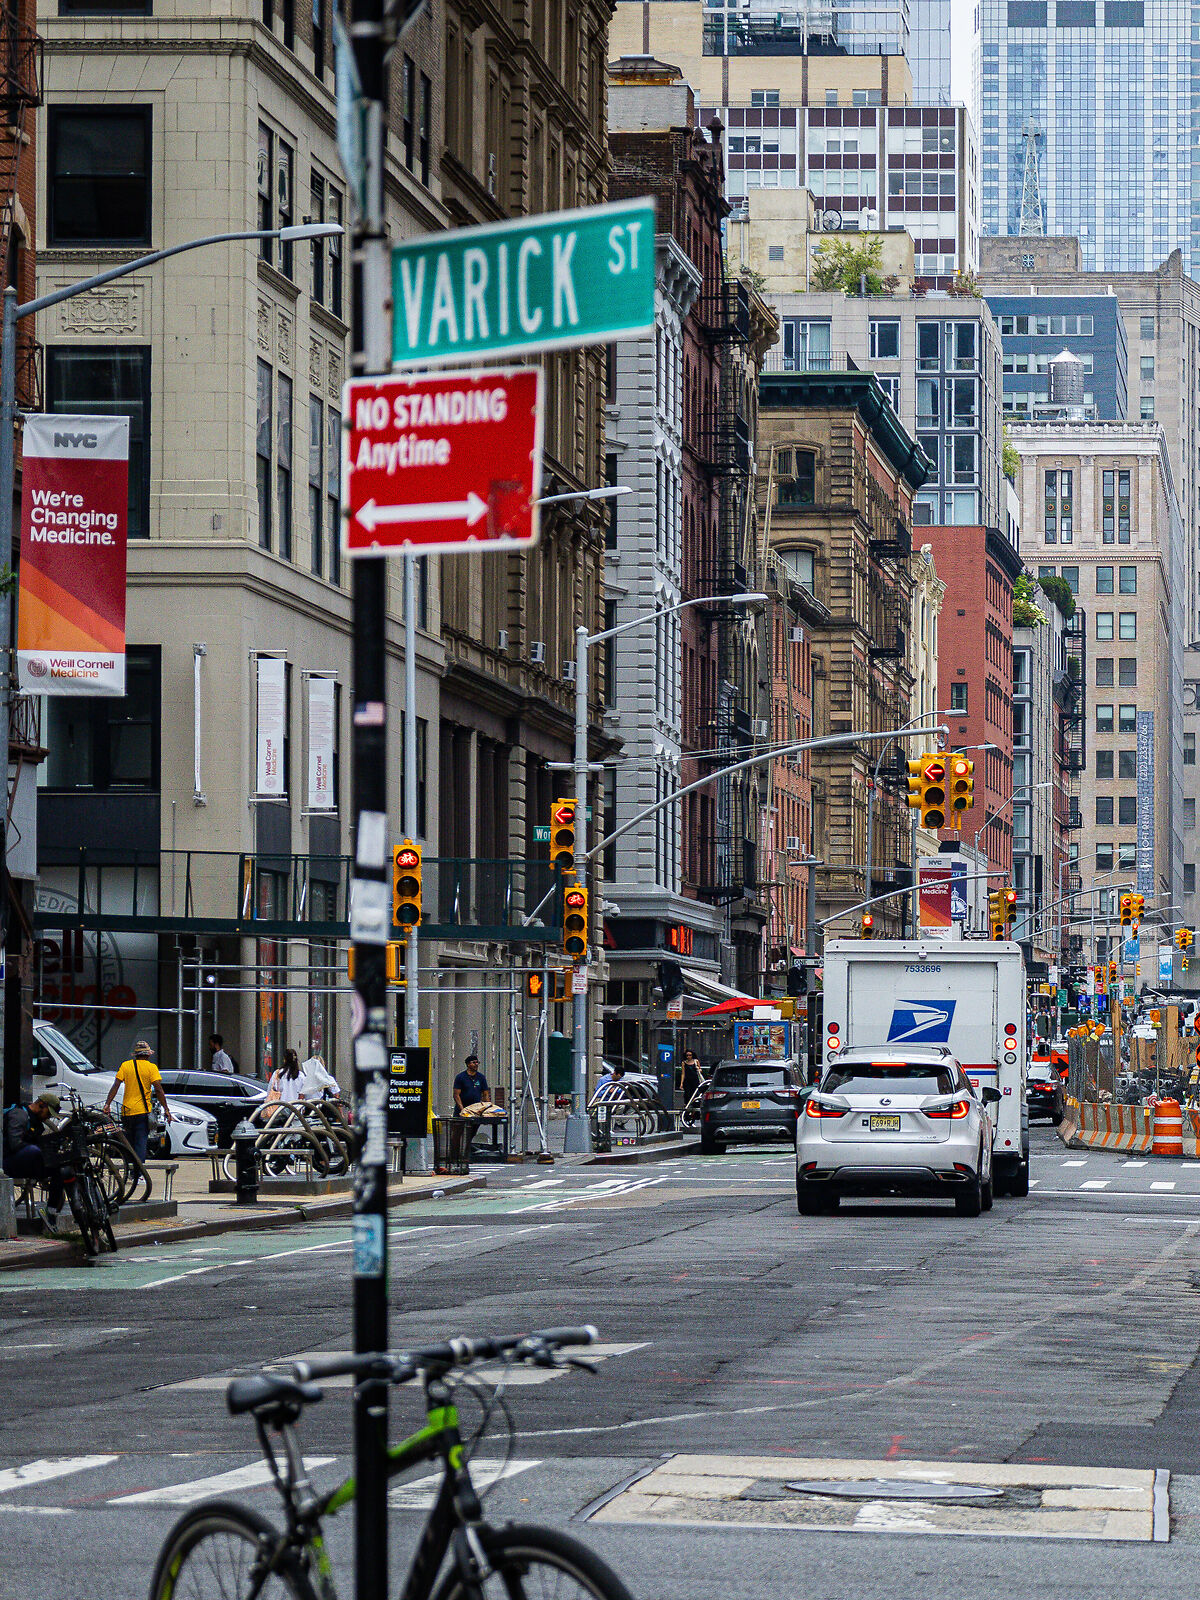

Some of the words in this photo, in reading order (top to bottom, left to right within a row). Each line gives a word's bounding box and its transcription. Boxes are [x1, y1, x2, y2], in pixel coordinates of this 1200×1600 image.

[401, 232, 579, 349] VARICK
[608, 221, 641, 275] ST
[356, 397, 390, 431] NO
[394, 388, 508, 429] STANDING
[53, 433, 97, 449] NYC
[356, 434, 450, 475] Anytime
[31, 490, 84, 507] We're
[30, 508, 119, 530] Changing
[30, 526, 116, 545] Medicine.
[49, 658, 75, 670] Weill
[76, 659, 115, 670] Cornell
[49, 668, 99, 679] Medicine
[389, 1095, 407, 1103] during
